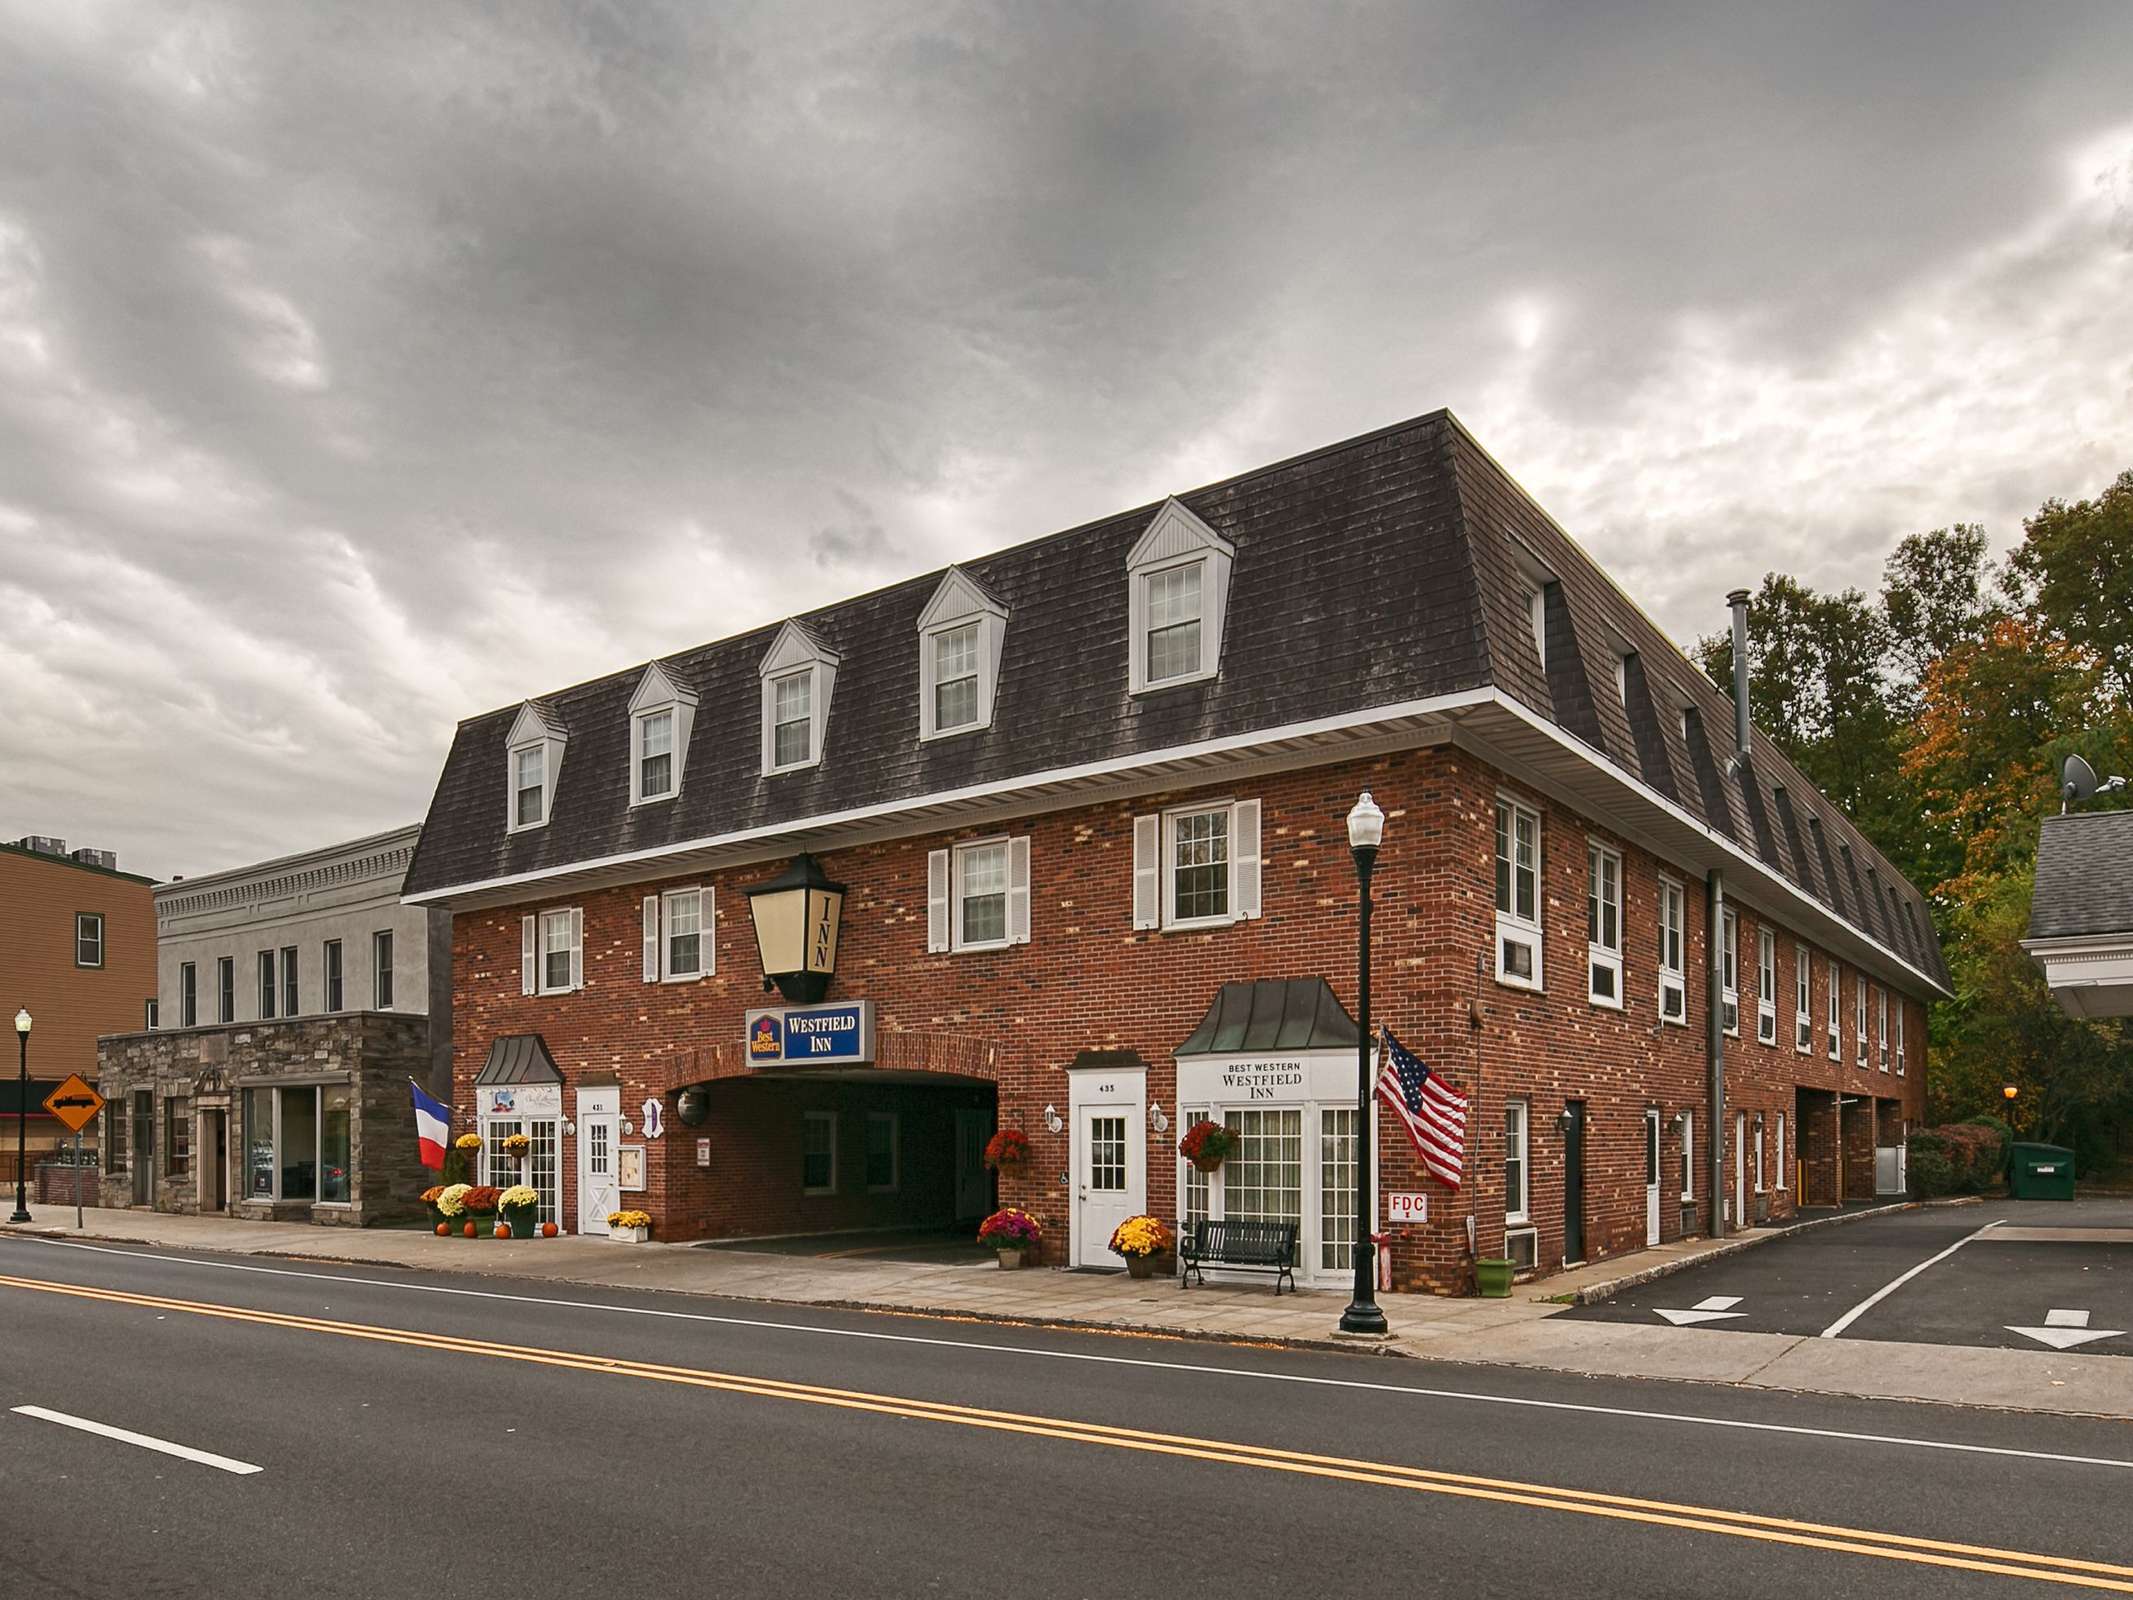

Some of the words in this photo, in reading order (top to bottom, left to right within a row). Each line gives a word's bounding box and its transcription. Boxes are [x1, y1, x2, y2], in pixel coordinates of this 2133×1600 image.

[814, 896, 832, 968] INN
[788, 1015, 856, 1034] WESTFIELD
[757, 1031, 773, 1042] Best
[751, 1040, 780, 1053] Western
[810, 1036, 832, 1052] INN
[1228, 1064, 1251, 1073] BEST
[1254, 1062, 1300, 1072] WESTERN
[1223, 1073, 1302, 1086] WESTFIELD
[1250, 1087, 1275, 1099] INN
[1392, 1196, 1424, 1211] FDC
